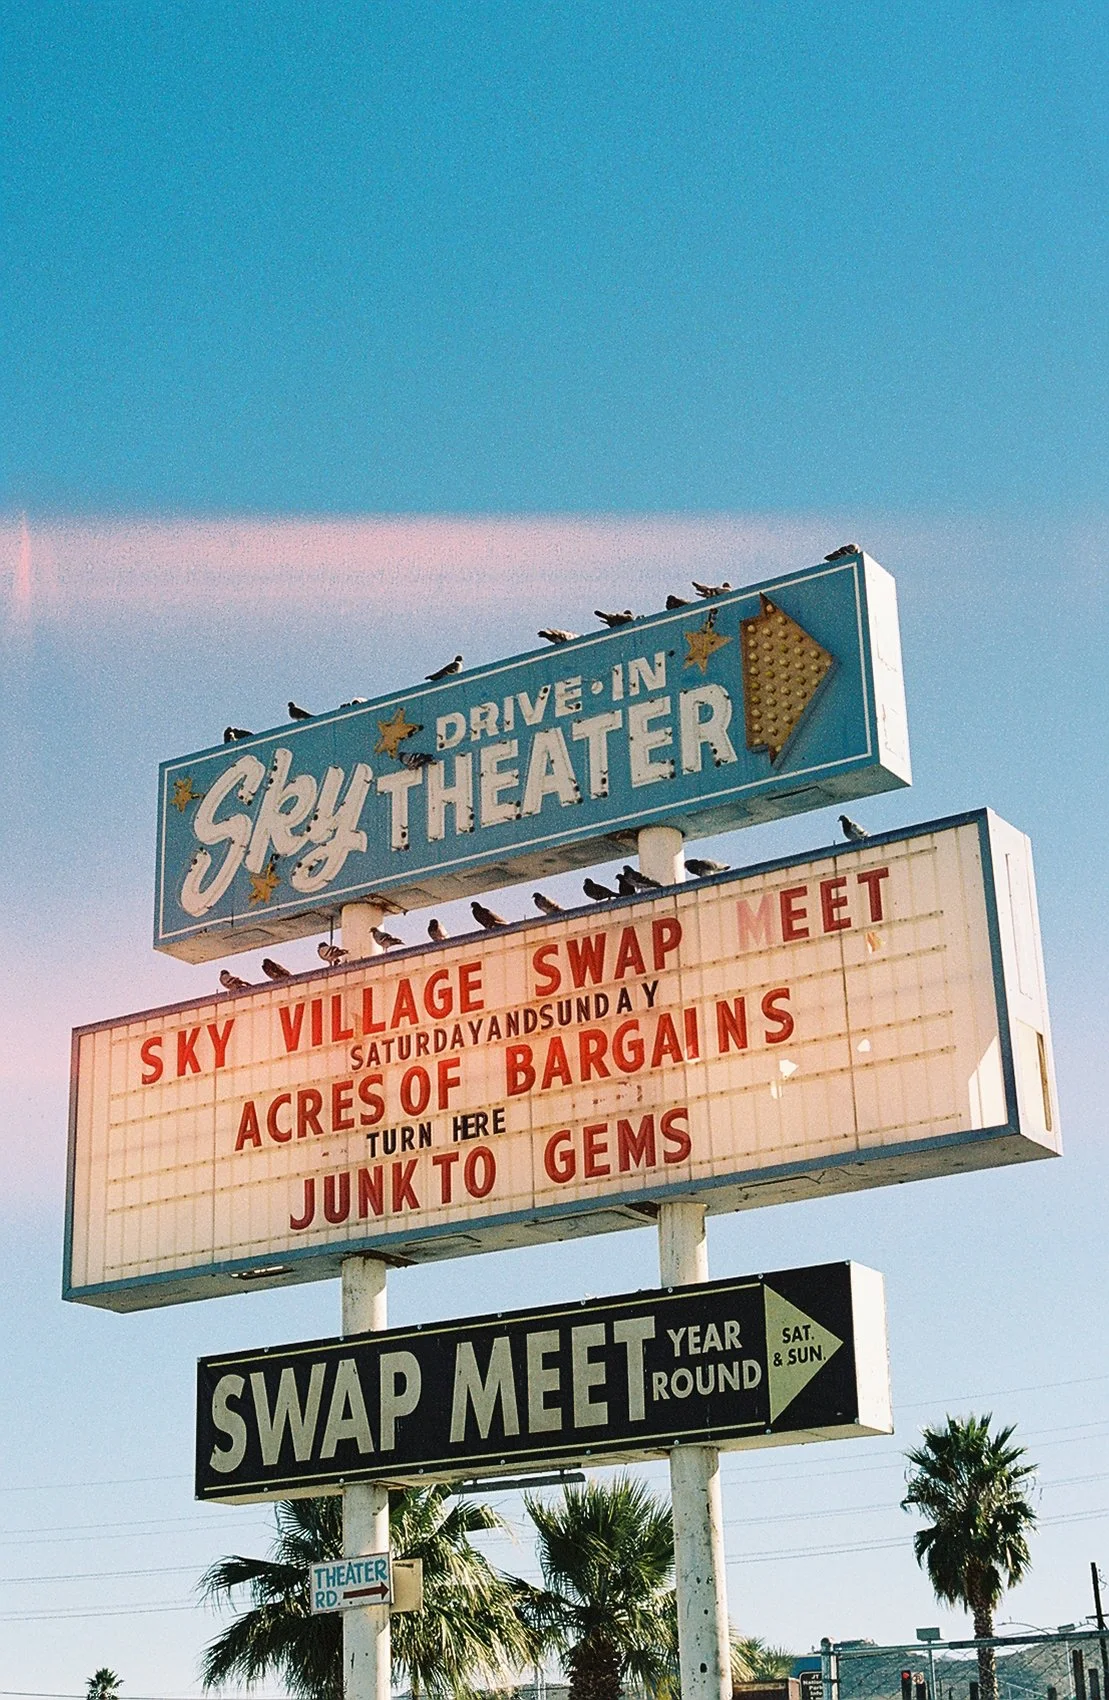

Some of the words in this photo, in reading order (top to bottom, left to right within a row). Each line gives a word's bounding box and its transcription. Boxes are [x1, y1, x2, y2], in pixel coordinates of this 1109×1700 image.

[181, 748, 373, 917] Sky
[377, 684, 738, 852] THEATER
[140, 1018, 235, 1085] SKY
[278, 964, 485, 1052] VILLAGE
[532, 917, 682, 997] SWAP
[736, 867, 890, 950] MEET
[506, 987, 795, 1098] BARGAINS
[366, 1121, 432, 1158] TURN
[452, 1107, 506, 1142] HERE
[290, 1158, 420, 1231] JUNK
[432, 1145, 497, 1204] TO
[544, 1107, 692, 1185] GEMS
[666, 1320, 743, 1357] YEAR
[773, 1352, 783, 1367] &
[787, 1345, 827, 1366] SUN.
[782, 1324, 815, 1344] SAT.
[209, 1350, 422, 1474] SWAP
[449, 1315, 656, 1443] MEET
[652, 1359, 762, 1401] ROUND
[314, 1559, 388, 1589] THEATER
